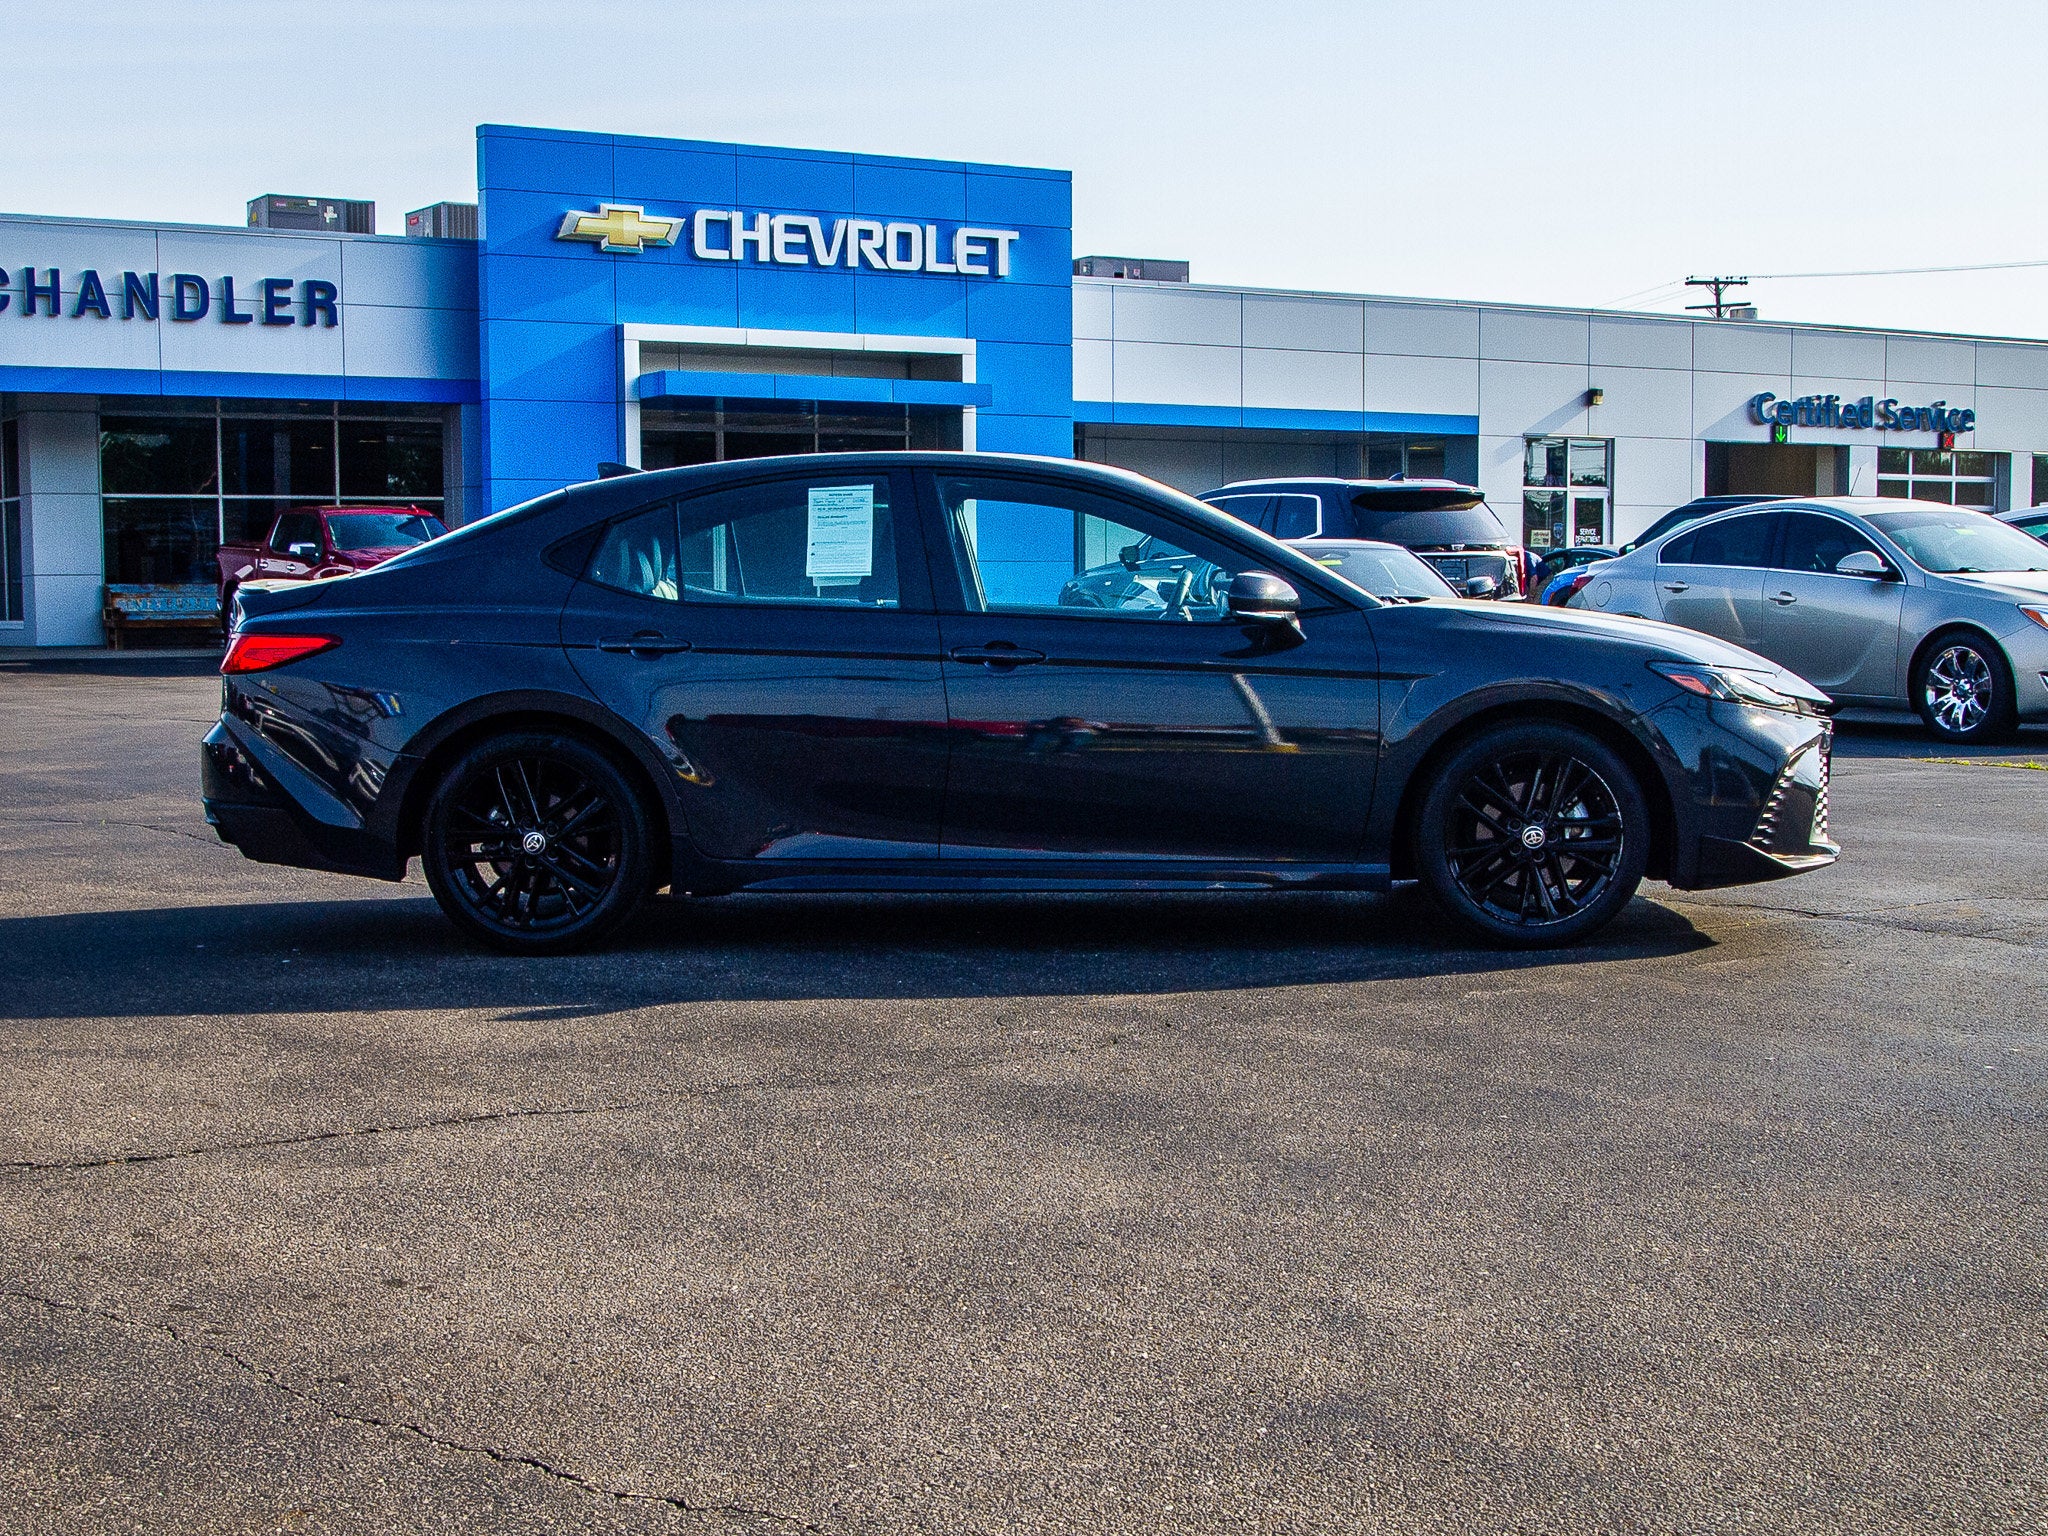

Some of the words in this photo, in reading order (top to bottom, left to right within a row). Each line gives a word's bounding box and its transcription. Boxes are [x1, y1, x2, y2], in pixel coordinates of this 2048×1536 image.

[694, 209, 1020, 277] CHEVROLET
[1752, 391, 1874, 428] Certified
[1880, 398, 1976, 432] Service
[1575, 535, 1601, 543] DEPARTMENT
[1579, 528, 1597, 536] SERVICE
